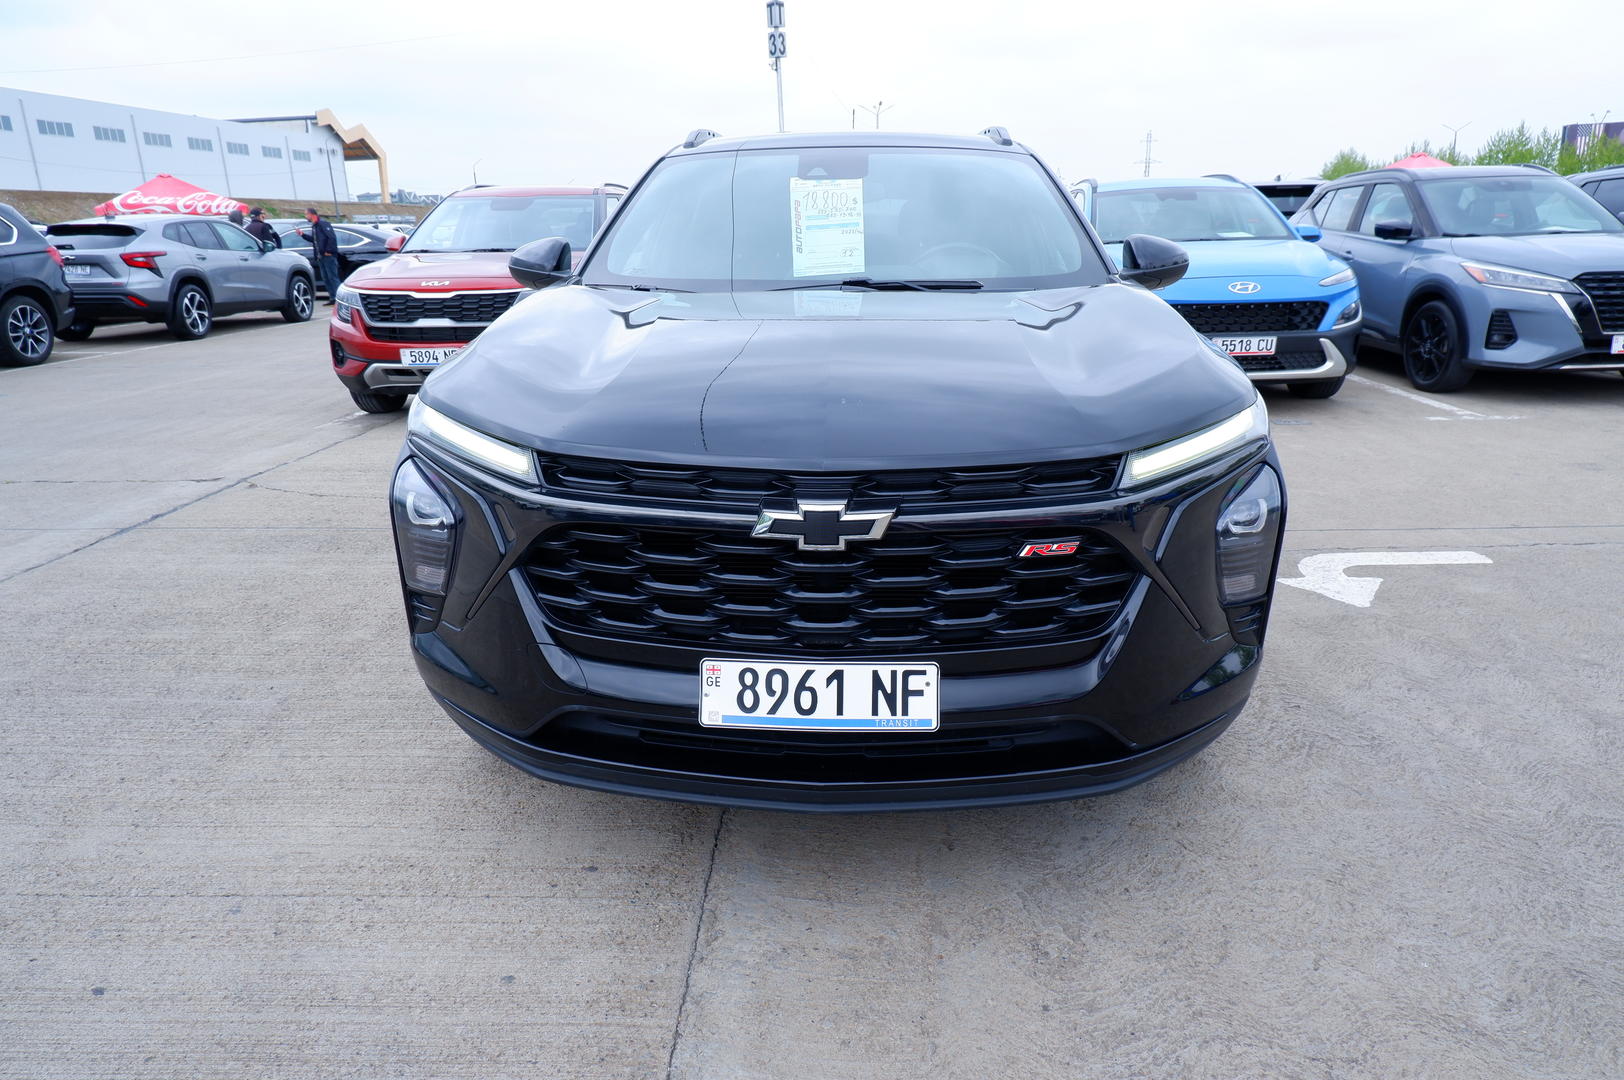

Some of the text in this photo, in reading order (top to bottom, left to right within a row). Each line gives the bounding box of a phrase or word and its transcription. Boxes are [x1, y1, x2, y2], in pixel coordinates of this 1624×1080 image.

[1221, 339, 1274, 352] 5518 CU
[409, 350, 439, 363] 5894
[1019, 541, 1080, 557] RS
[706, 676, 721, 687] GE
[736, 667, 927, 717] 8961 NF
[875, 719, 919, 728] TRANSIT
